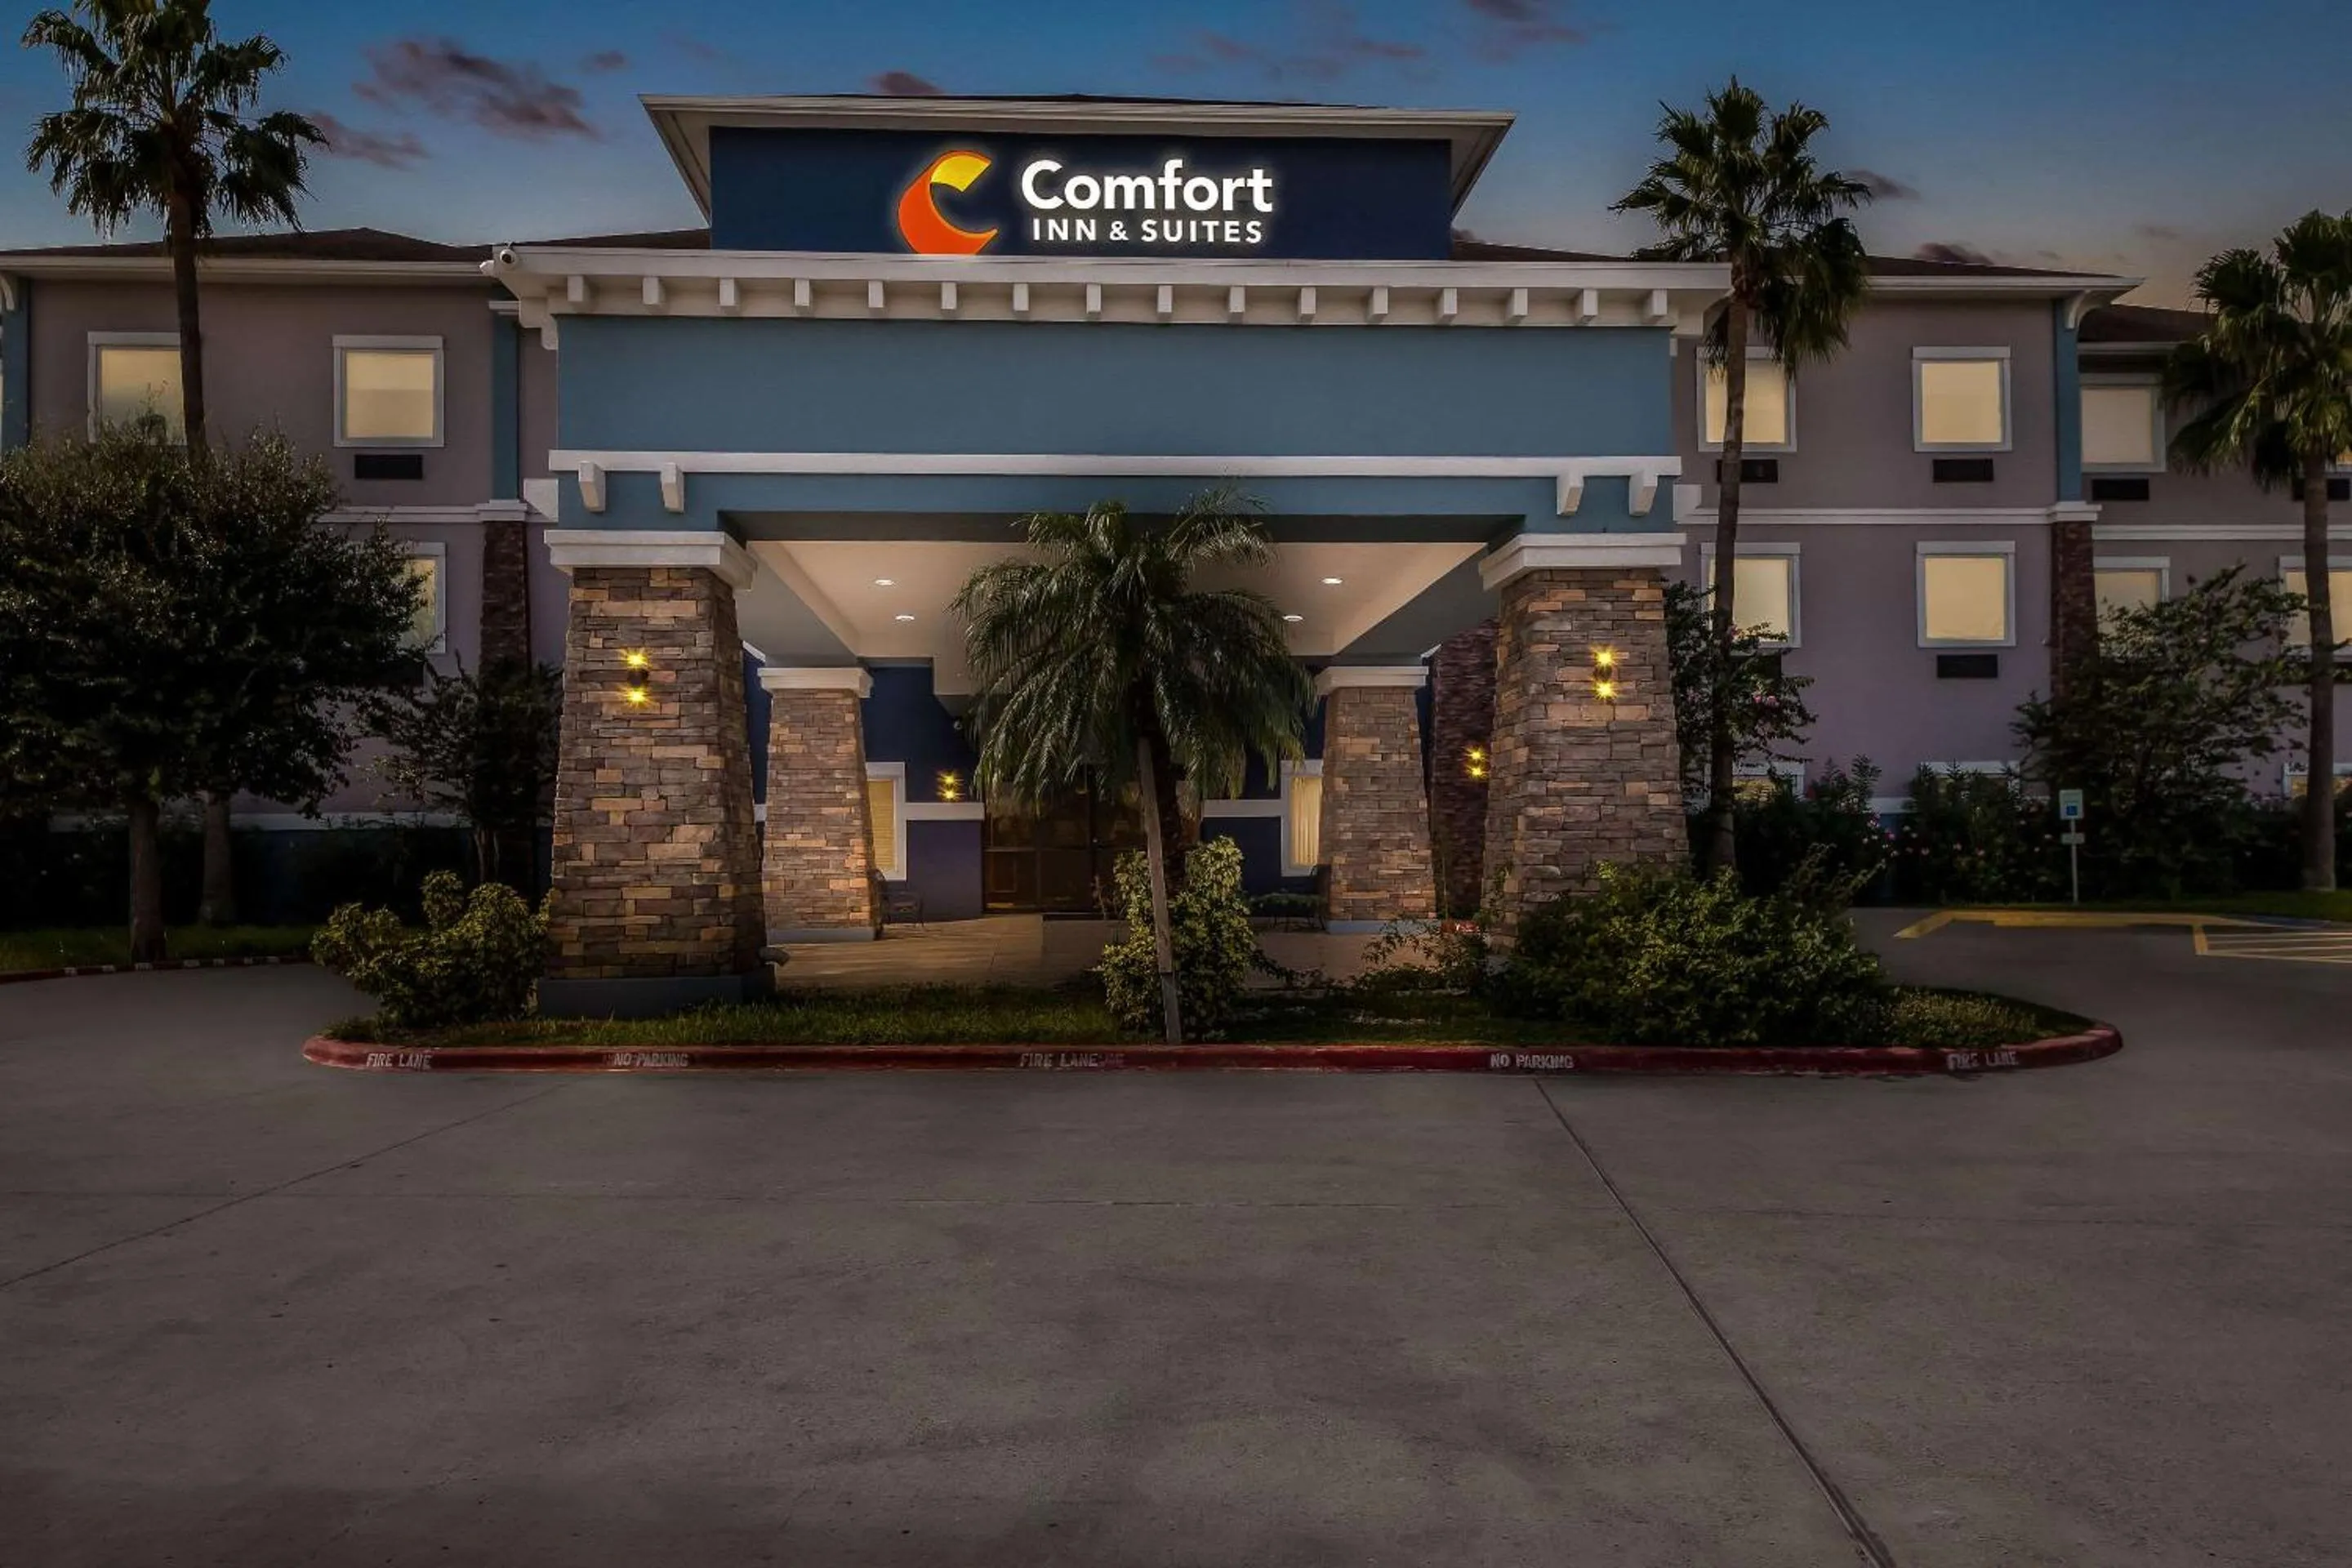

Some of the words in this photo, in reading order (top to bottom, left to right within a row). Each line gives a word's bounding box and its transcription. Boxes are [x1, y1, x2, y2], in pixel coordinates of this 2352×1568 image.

[1021, 159, 1272, 212] Comfort
[1032, 218, 1096, 241] INN
[1108, 220, 1129, 241] &
[1141, 220, 1262, 243] SUITES
[366, 1052, 394, 1067] FIRE
[399, 1052, 433, 1070] LANE
[614, 1052, 631, 1066] NO
[636, 1053, 688, 1067] PARKING
[1019, 1053, 1053, 1067] FIRE
[1059, 1053, 1098, 1067] LANE
[1490, 1054, 1510, 1067] NO
[1516, 1054, 1574, 1068] PARKING
